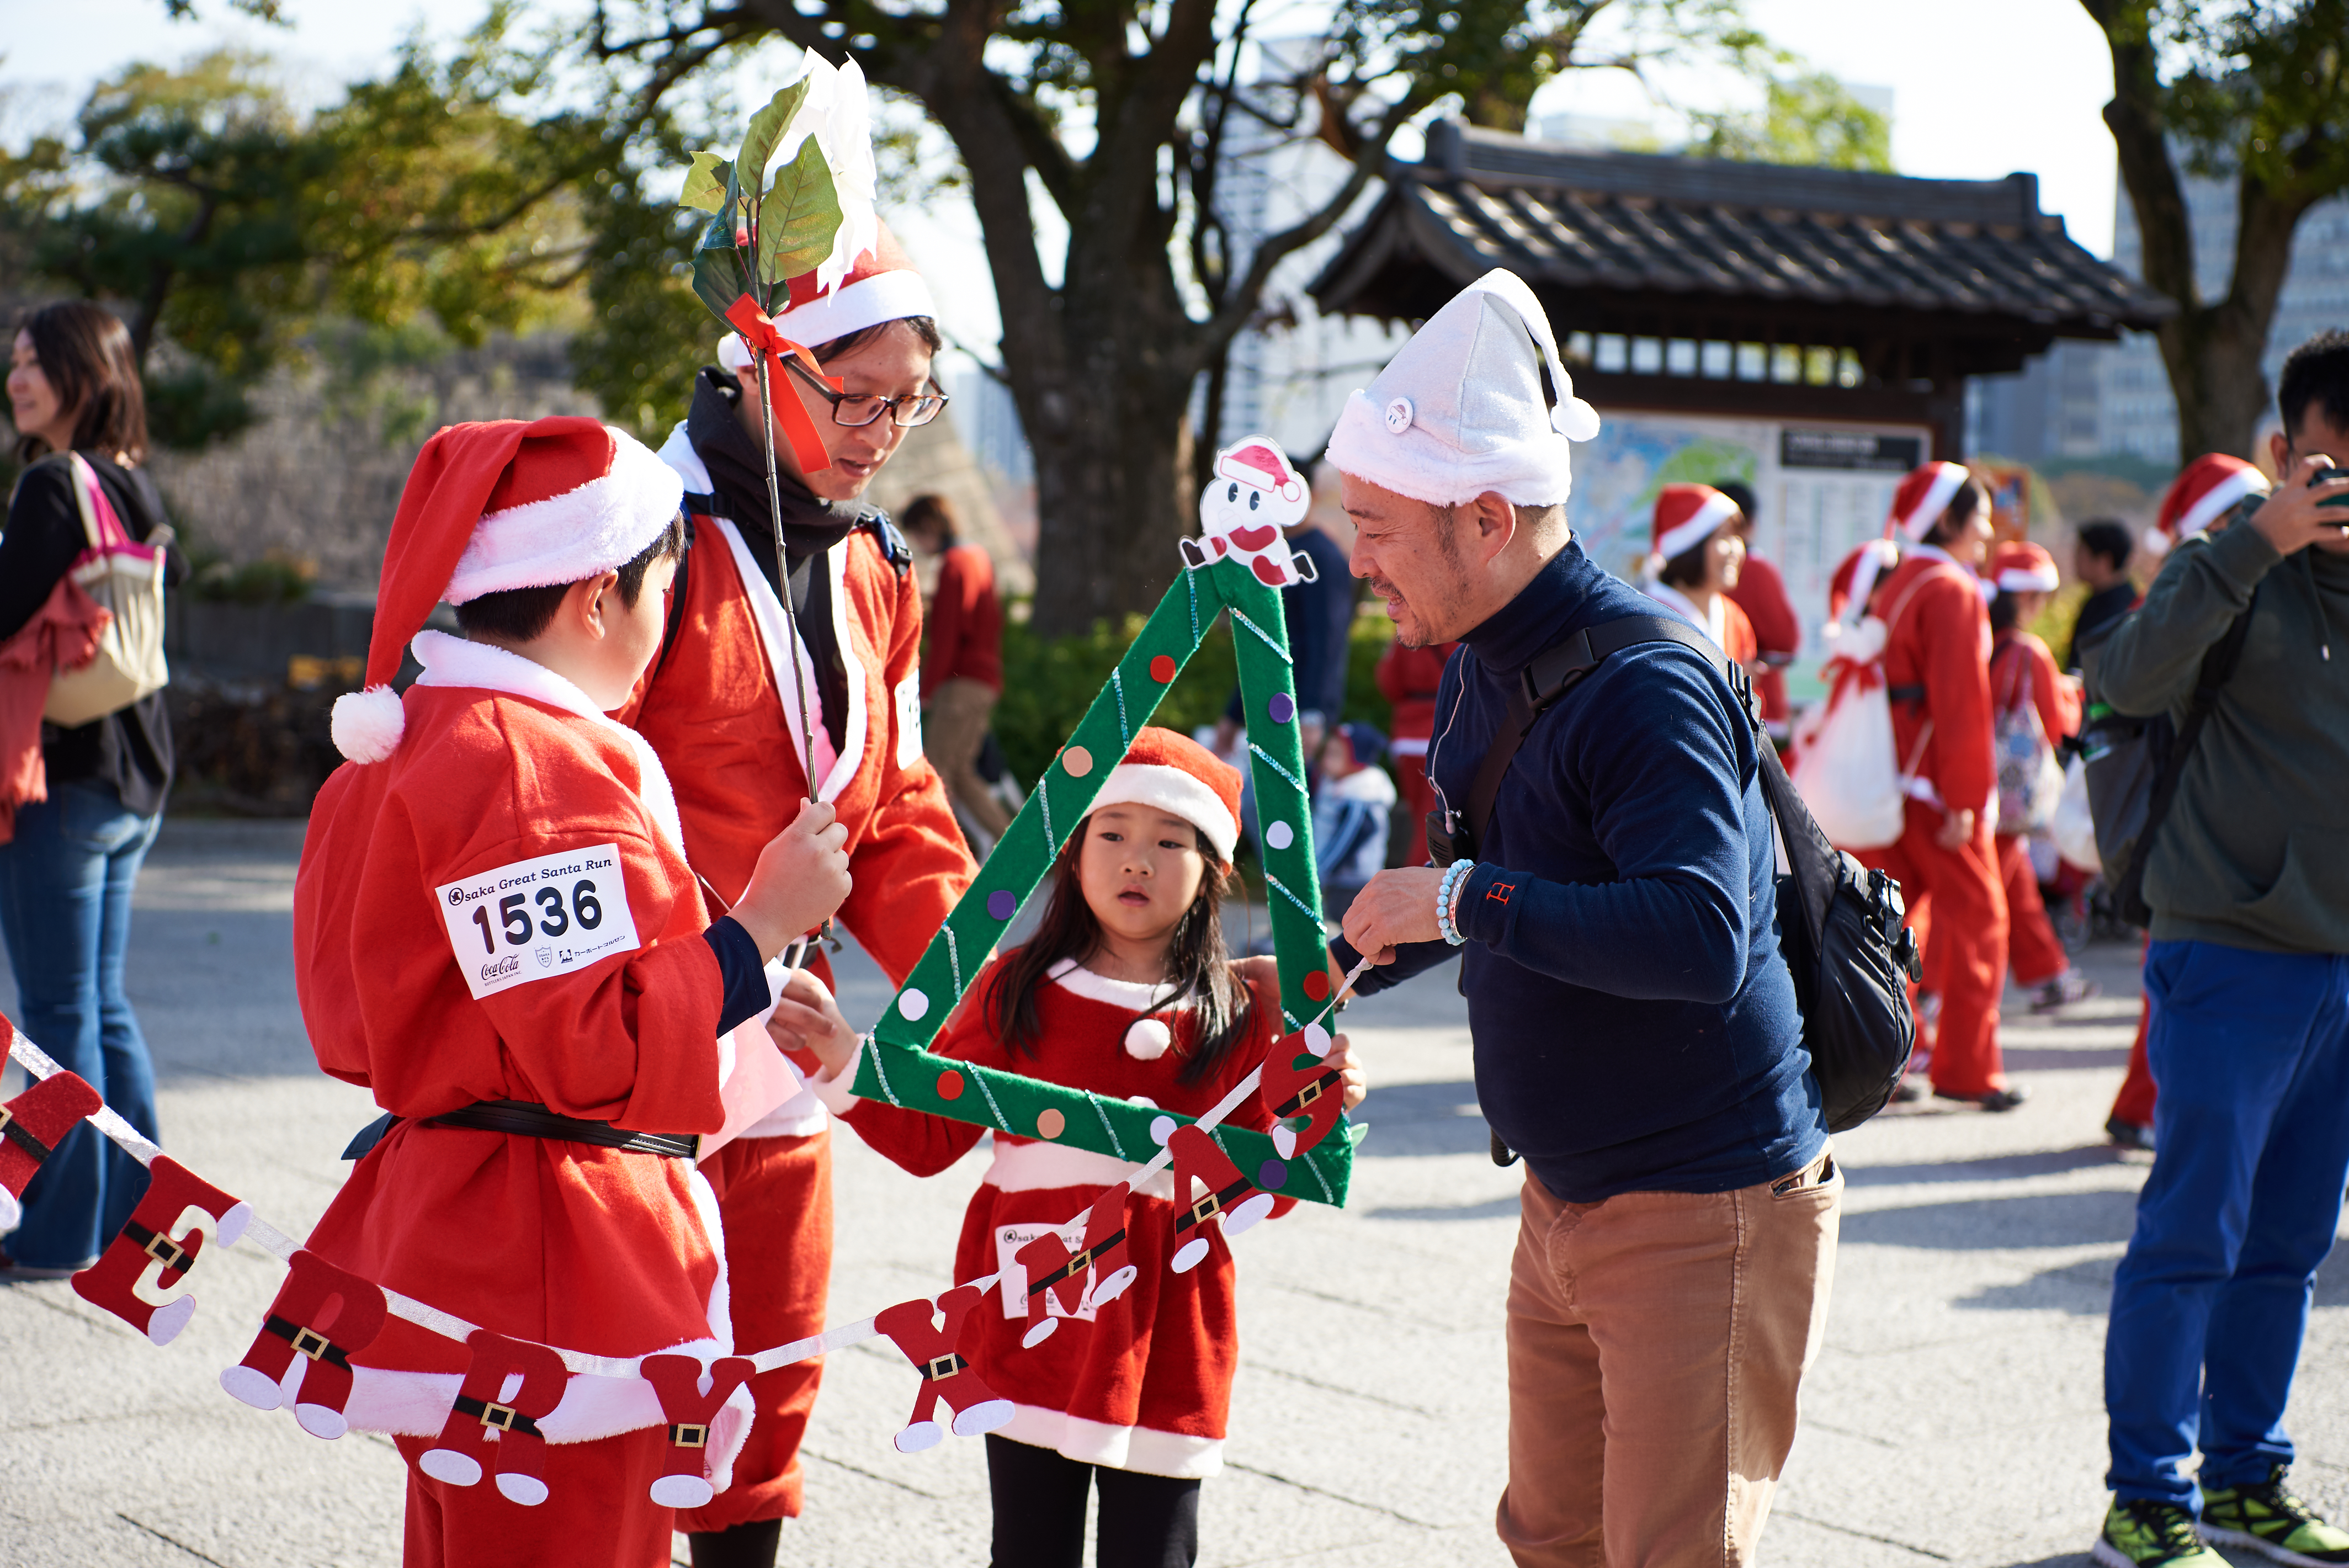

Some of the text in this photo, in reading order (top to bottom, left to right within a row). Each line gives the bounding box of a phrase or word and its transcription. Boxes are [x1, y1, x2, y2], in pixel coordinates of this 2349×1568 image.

[499, 871, 536, 890] Great
[541, 864, 582, 879] Santa
[585, 858, 612, 870] Run
[472, 879, 602, 954] 1536
[481, 953, 520, 981] Coca-Cola
[485, 977, 502, 986] BOTTLERS
